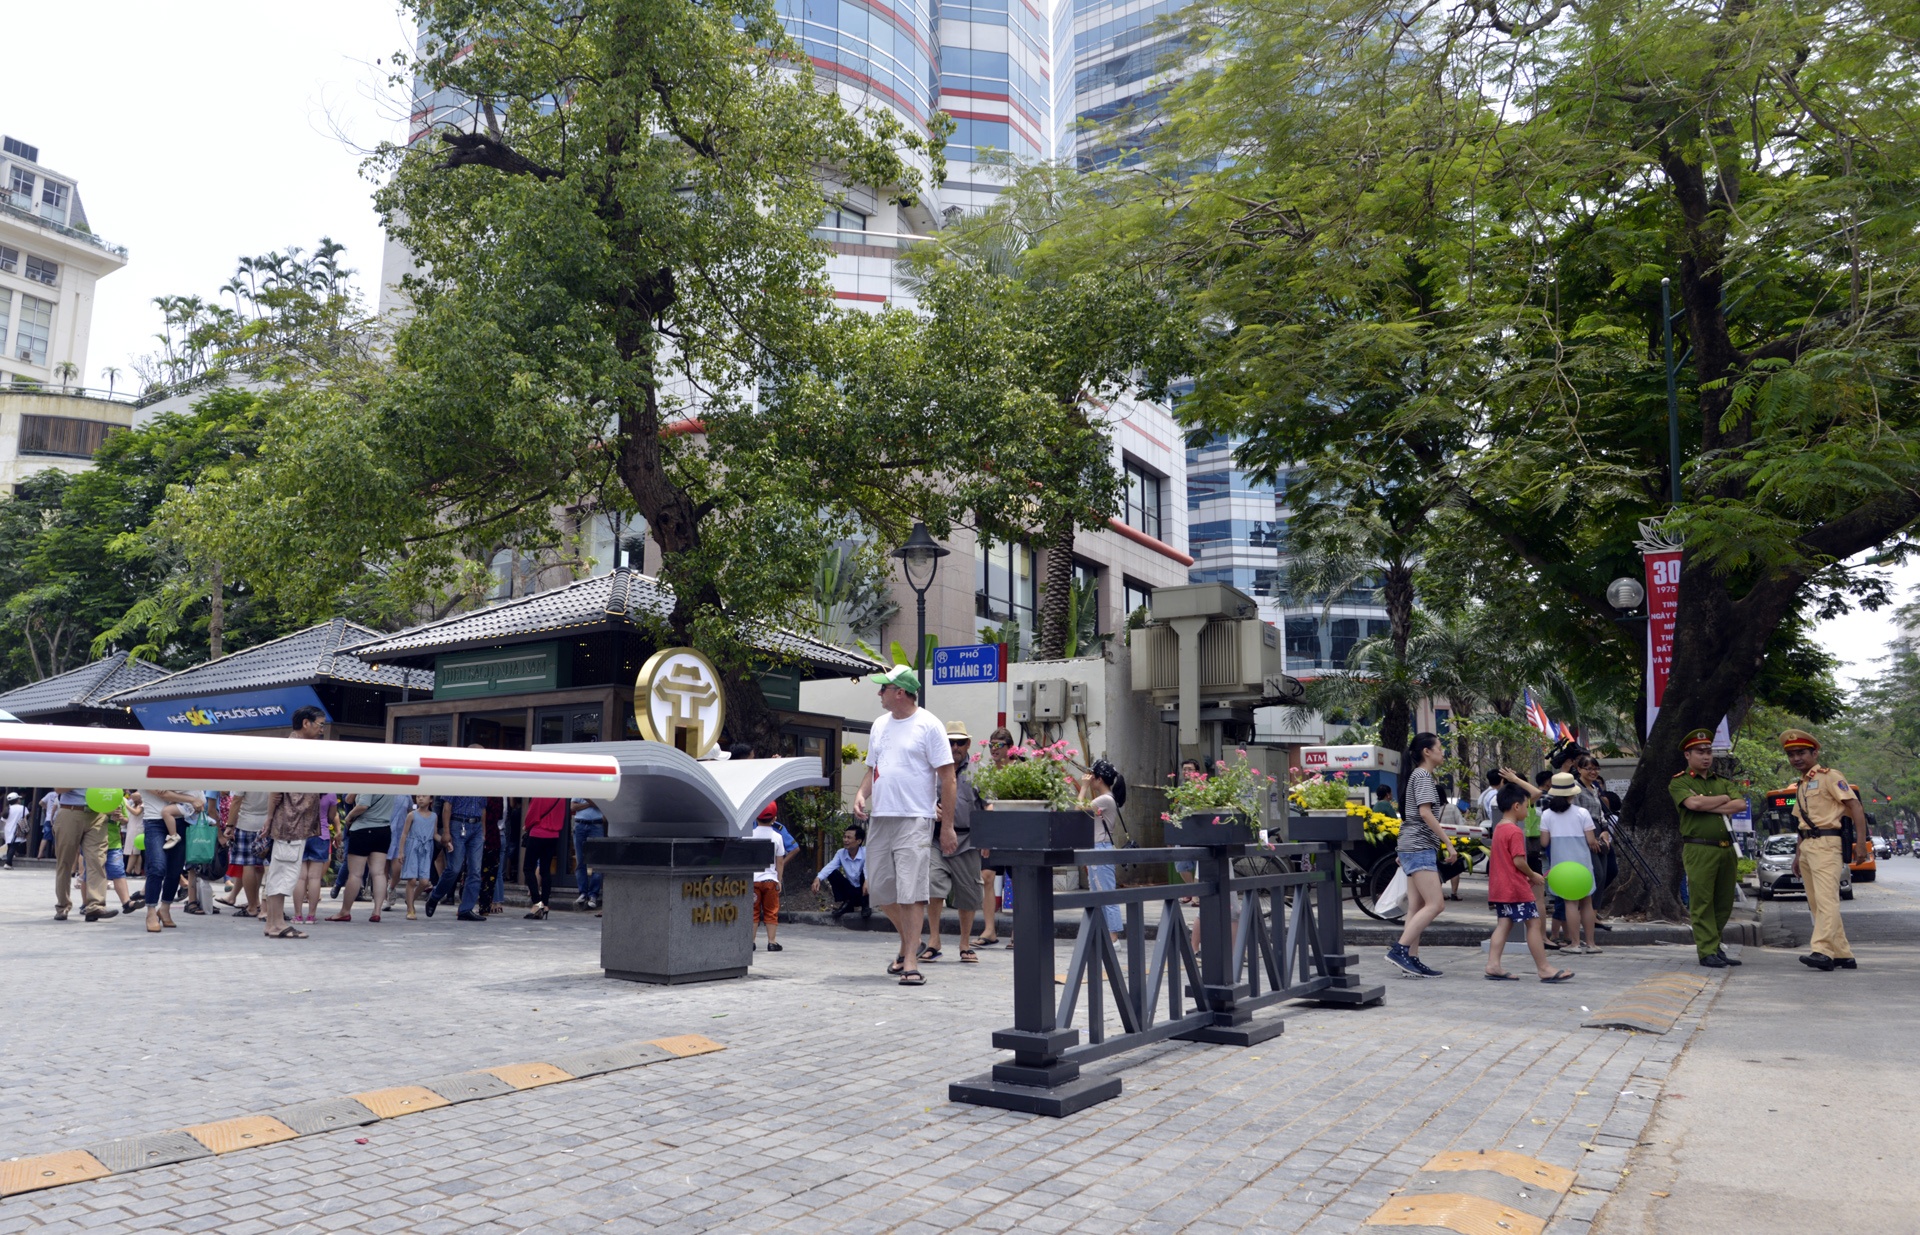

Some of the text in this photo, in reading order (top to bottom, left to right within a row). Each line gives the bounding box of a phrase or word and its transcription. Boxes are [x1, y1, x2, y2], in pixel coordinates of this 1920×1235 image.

[1651, 611, 1671, 620] NGÀY
[960, 648, 979, 658] PHỐ
[938, 662, 992, 679] 19 THÁNG 12
[167, 712, 188, 724] NHÀ
[185, 706, 218, 726] SÁCH
[258, 705, 284, 717] NAM
[1306, 754, 1327, 763] ATM
[682, 875, 748, 898] PHỐ SÁCH
[692, 902, 738, 925] HÀ NỘI
